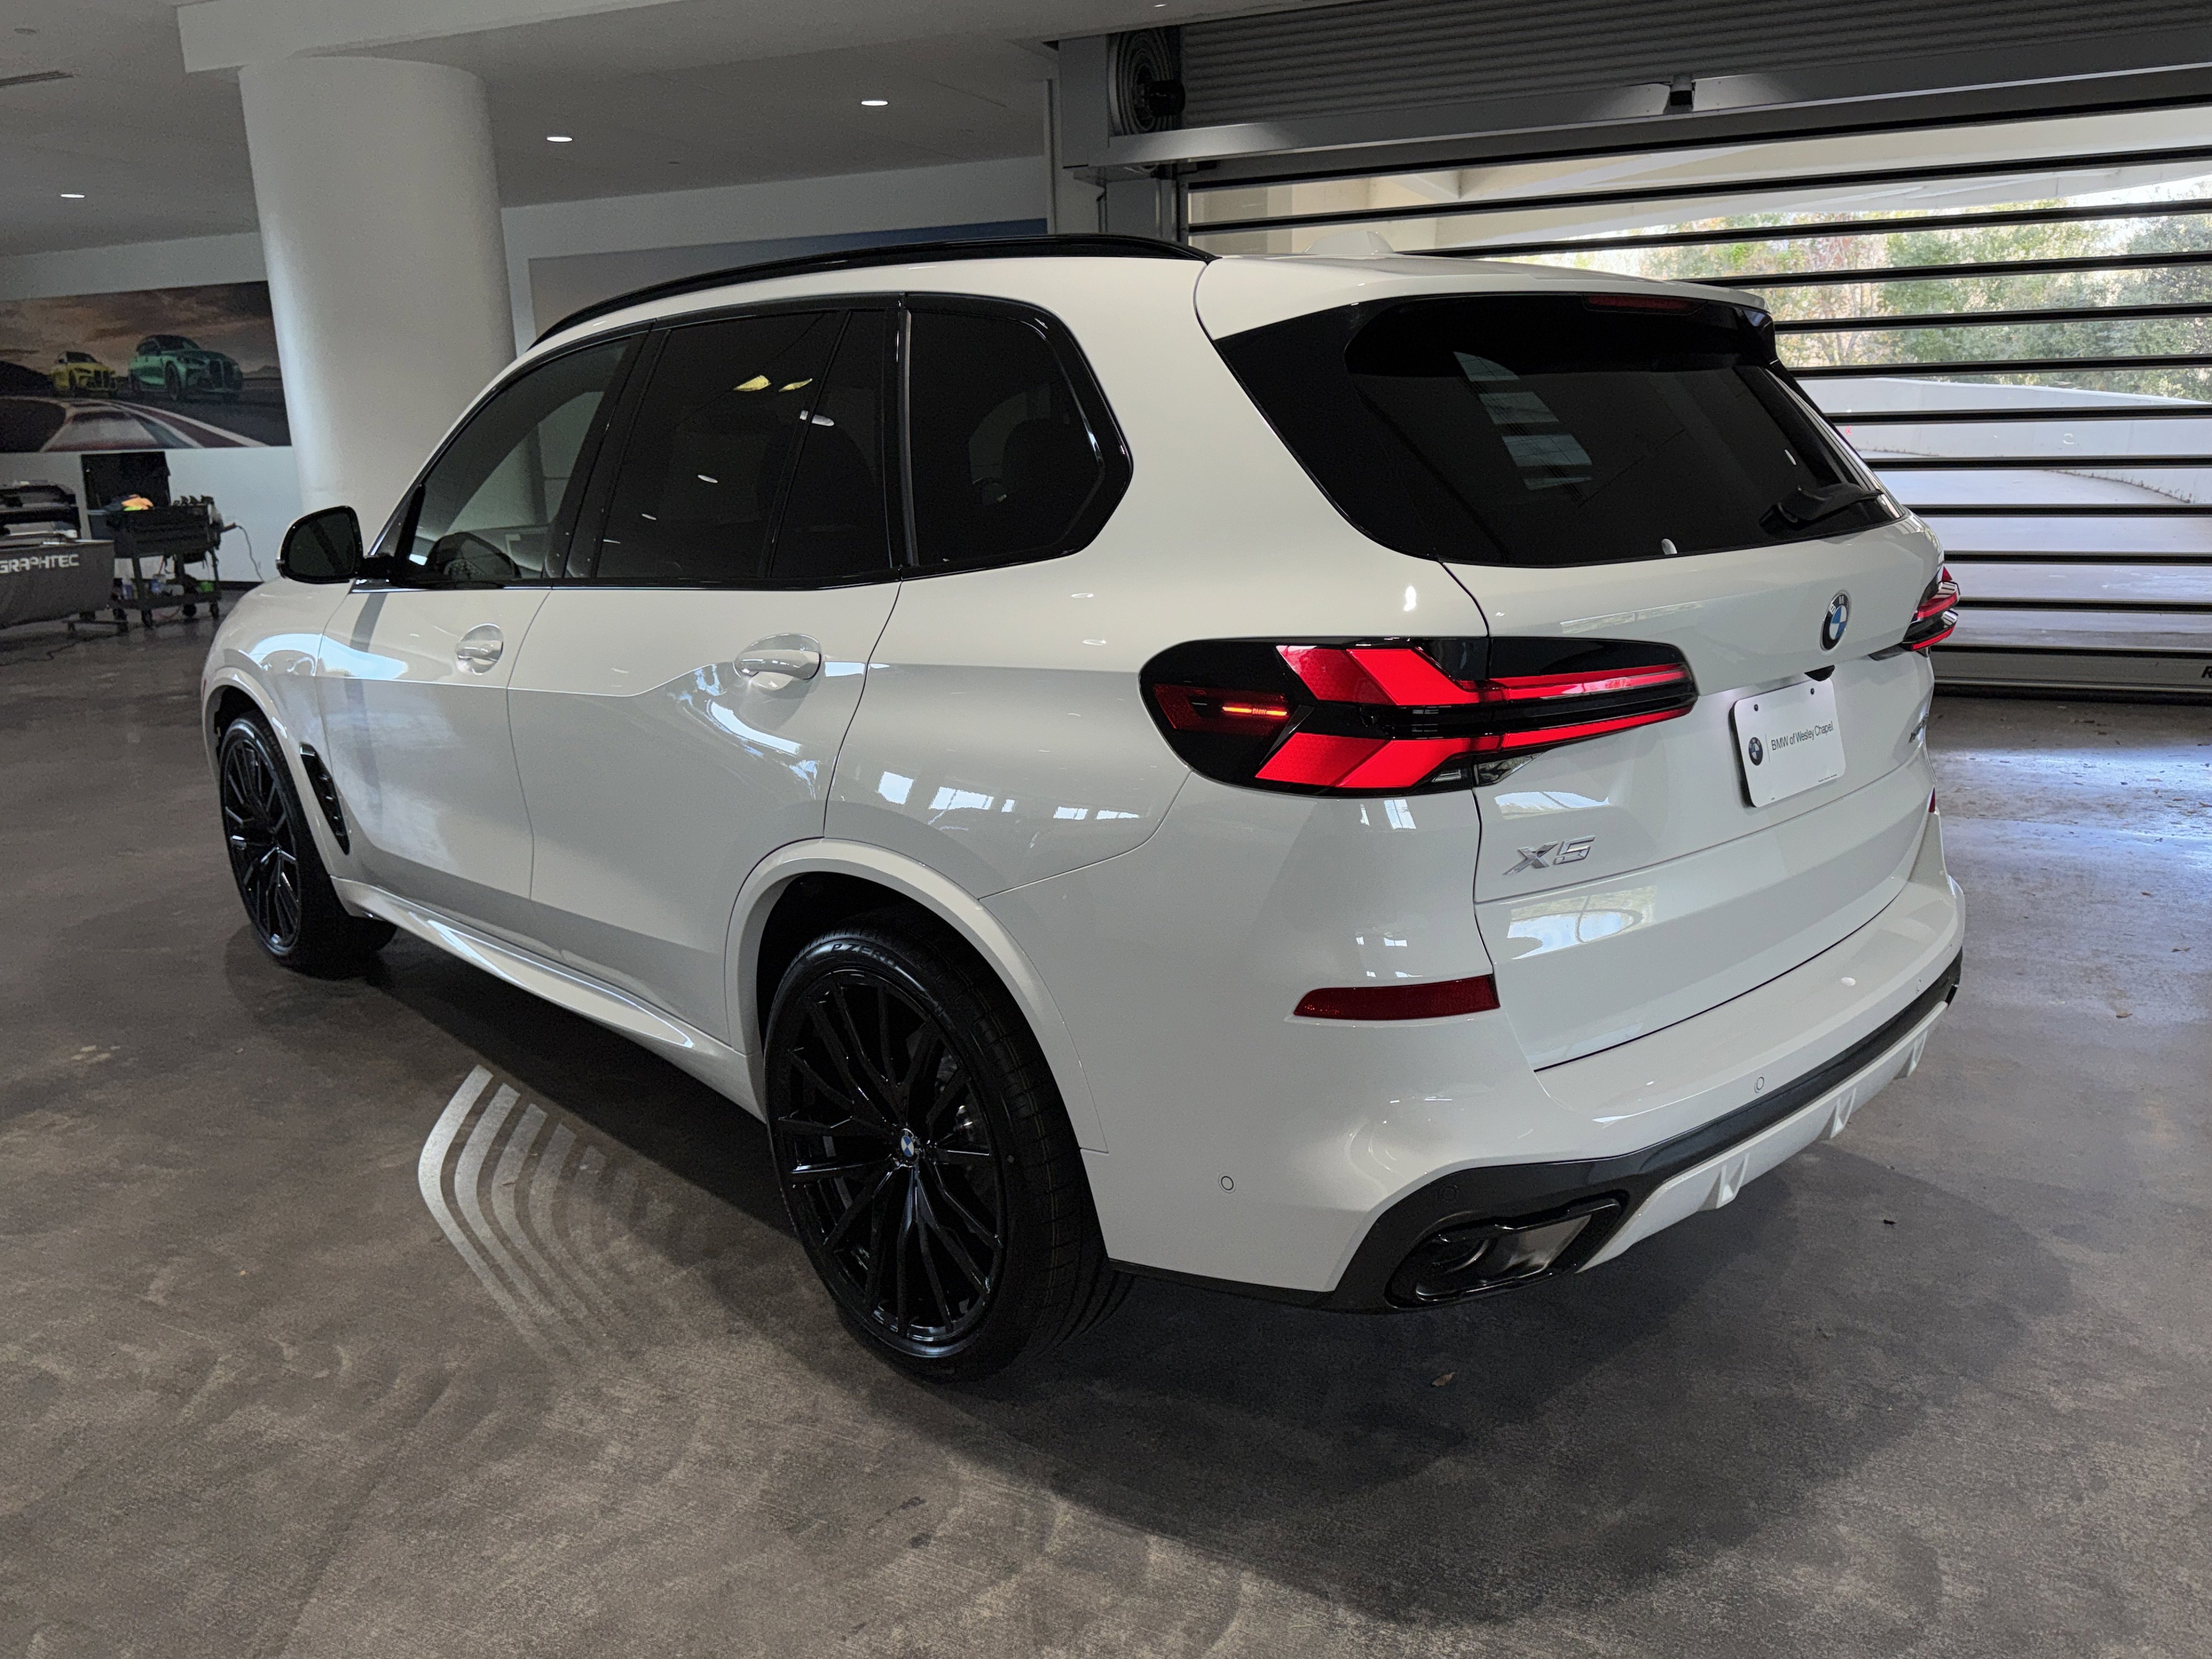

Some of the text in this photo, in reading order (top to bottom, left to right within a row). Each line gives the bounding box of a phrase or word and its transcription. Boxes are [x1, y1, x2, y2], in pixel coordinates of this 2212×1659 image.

[0, 554, 80, 574] GRAPHTEC
[1771, 720, 1834, 751] BMW of Wesley Chapel
[1502, 834, 1596, 876] X5
